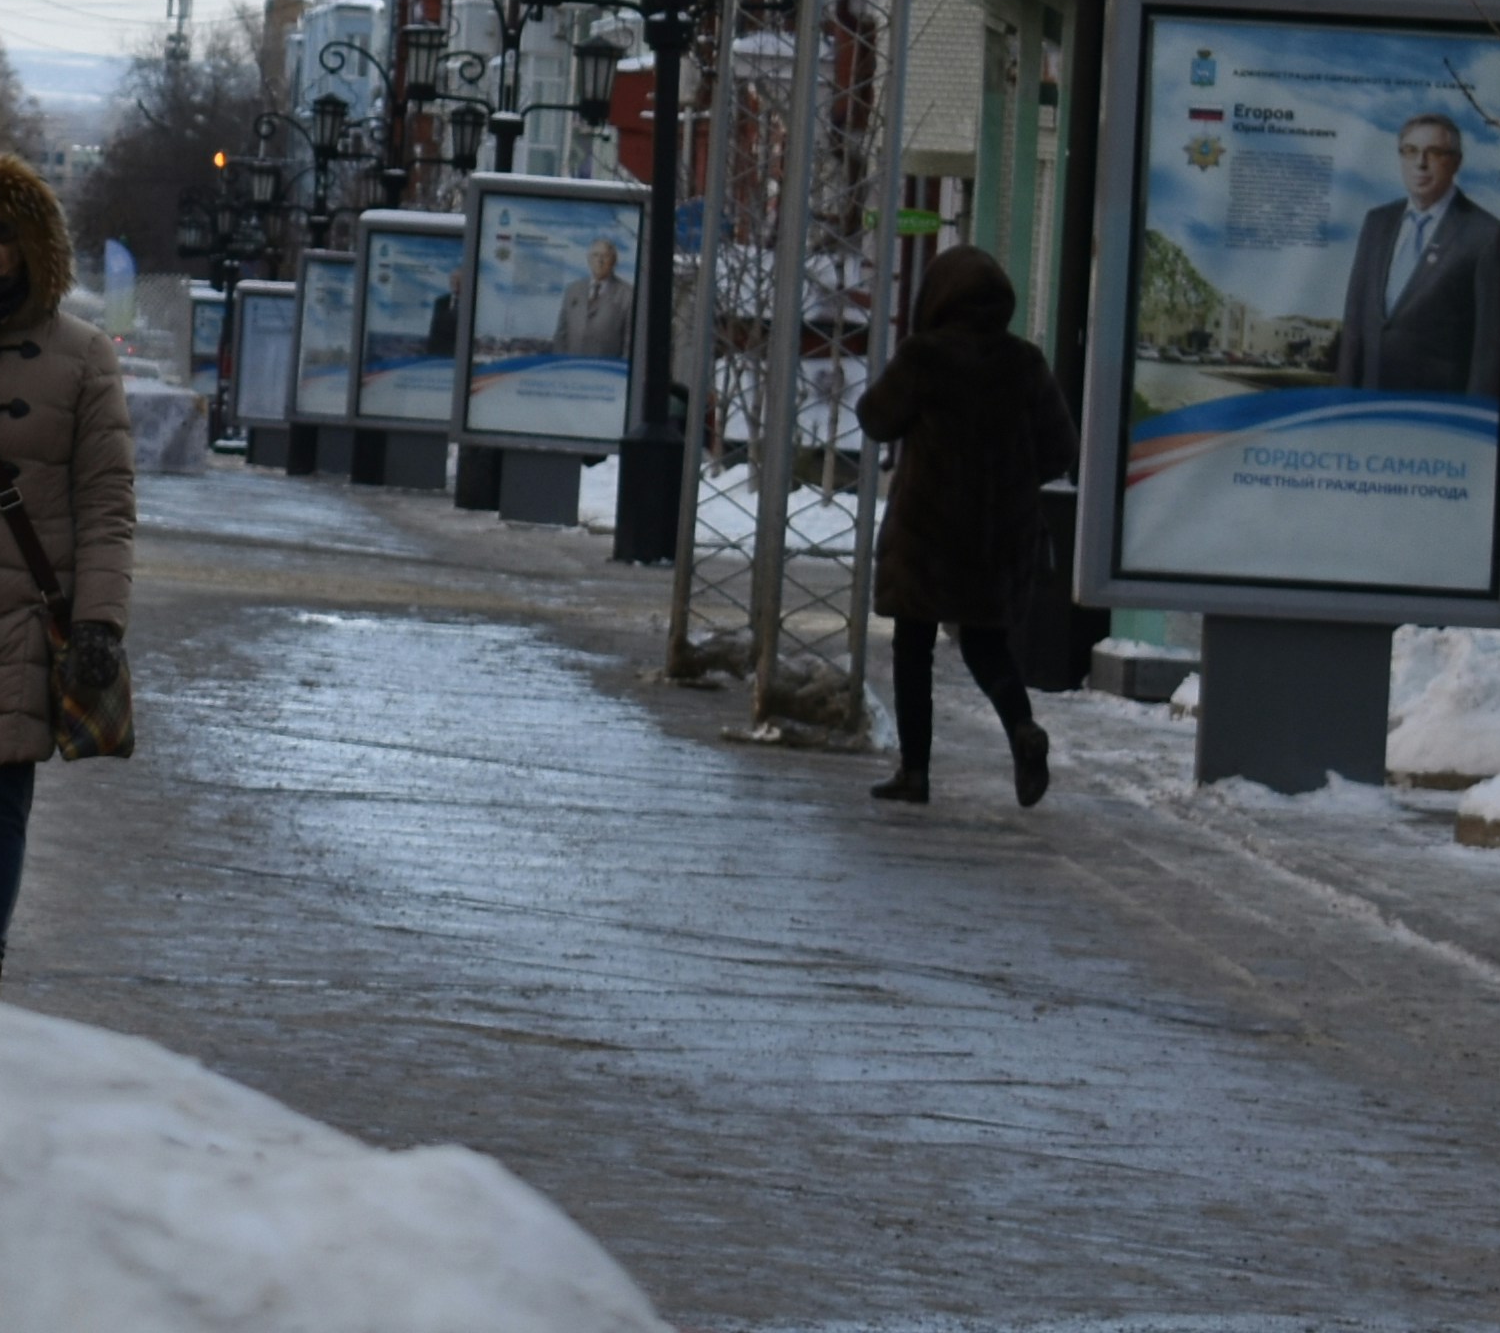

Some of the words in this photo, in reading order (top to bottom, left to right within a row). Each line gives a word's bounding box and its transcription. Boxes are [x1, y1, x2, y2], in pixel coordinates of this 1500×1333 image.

[1233, 103, 1295, 123] Егоров
[1242, 446, 1360, 472] ГОРДОСТЬ
[1365, 453, 1467, 480] САМАРЫ
[1232, 471, 1315, 488] ПОЧЕТНЫЙ
[1316, 477, 1409, 495] ГРАЖДАНИН
[1410, 484, 1469, 502] ГОРОДА
